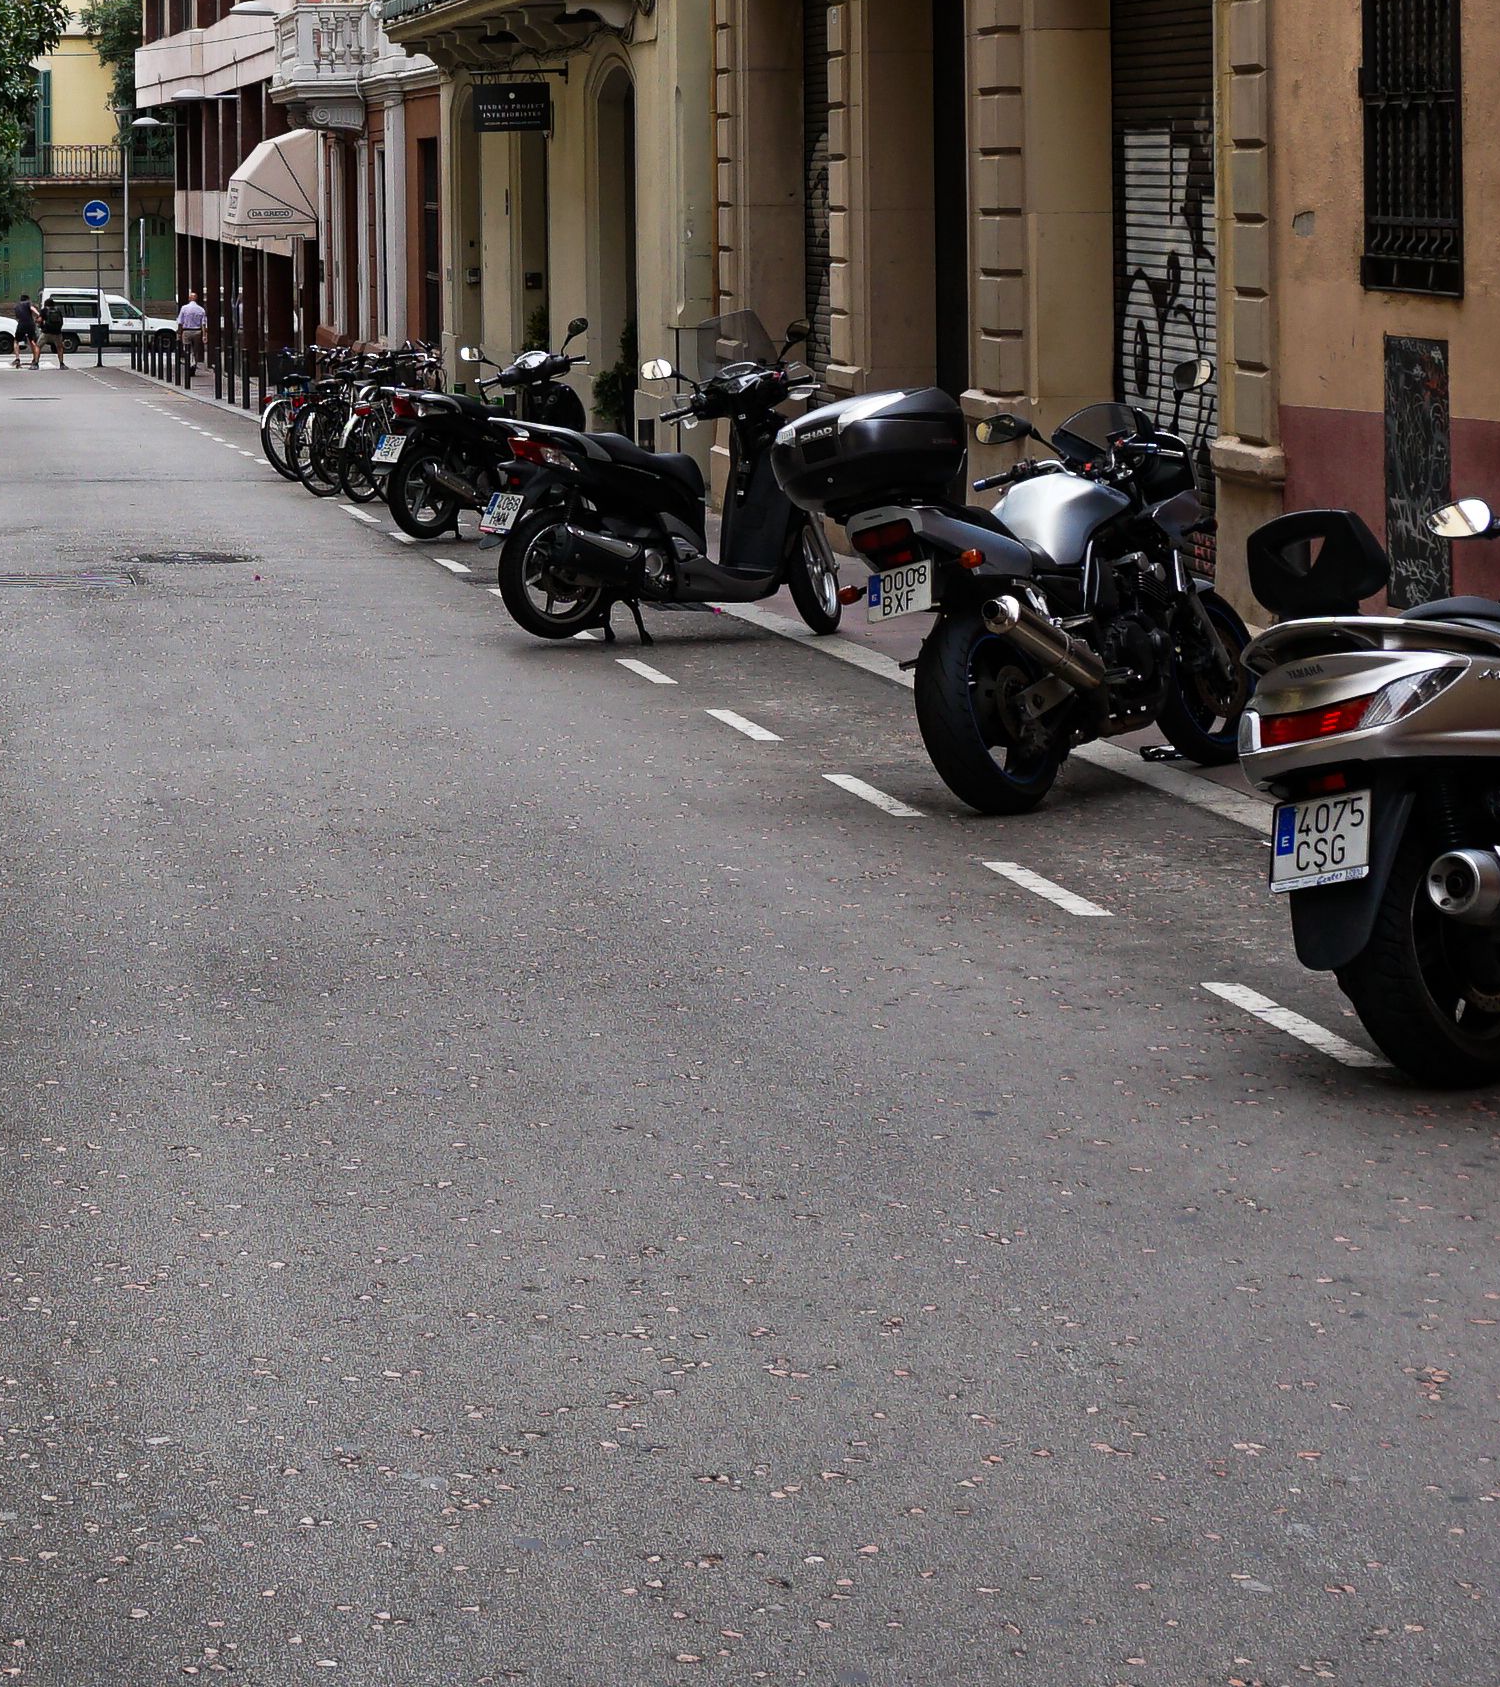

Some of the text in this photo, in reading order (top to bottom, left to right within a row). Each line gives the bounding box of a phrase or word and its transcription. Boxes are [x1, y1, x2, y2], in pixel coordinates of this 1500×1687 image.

[800, 427, 833, 442] SHAD
[882, 565, 927, 594] 0008
[882, 589, 916, 616] BXF
[1287, 664, 1324, 679] YAMAHA
[1298, 796, 1365, 837] 4075
[1281, 835, 1290, 847] E
[1296, 834, 1346, 871] CSG
